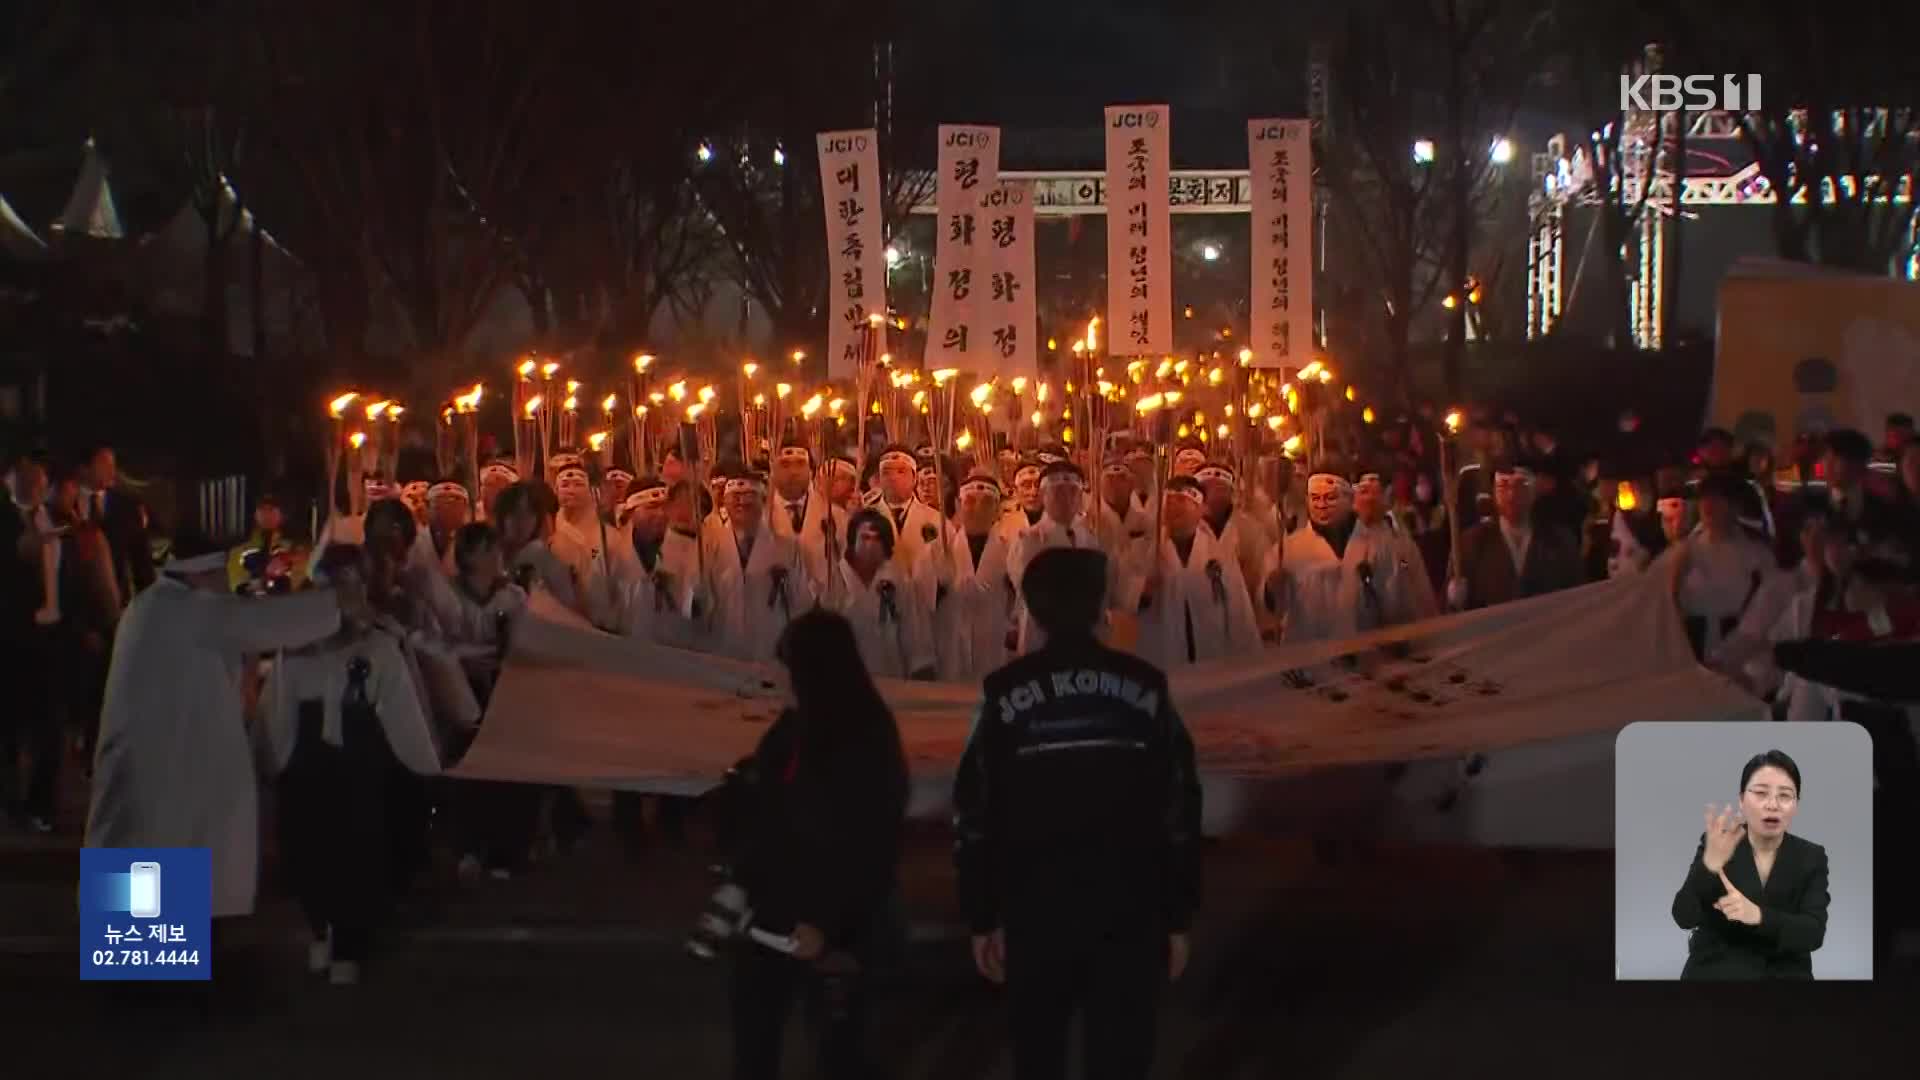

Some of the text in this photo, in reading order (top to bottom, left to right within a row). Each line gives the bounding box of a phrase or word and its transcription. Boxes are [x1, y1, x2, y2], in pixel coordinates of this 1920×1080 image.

[1113, 113, 1142, 128] JCI
[945, 132, 974, 147] JCI
[1255, 127, 1285, 141] JCI
[824, 137, 853, 153] JCI
[980, 190, 1009, 208] JCI
[943, 157, 979, 352] 평화정의
[998, 669, 1159, 723] JCI KOREA
